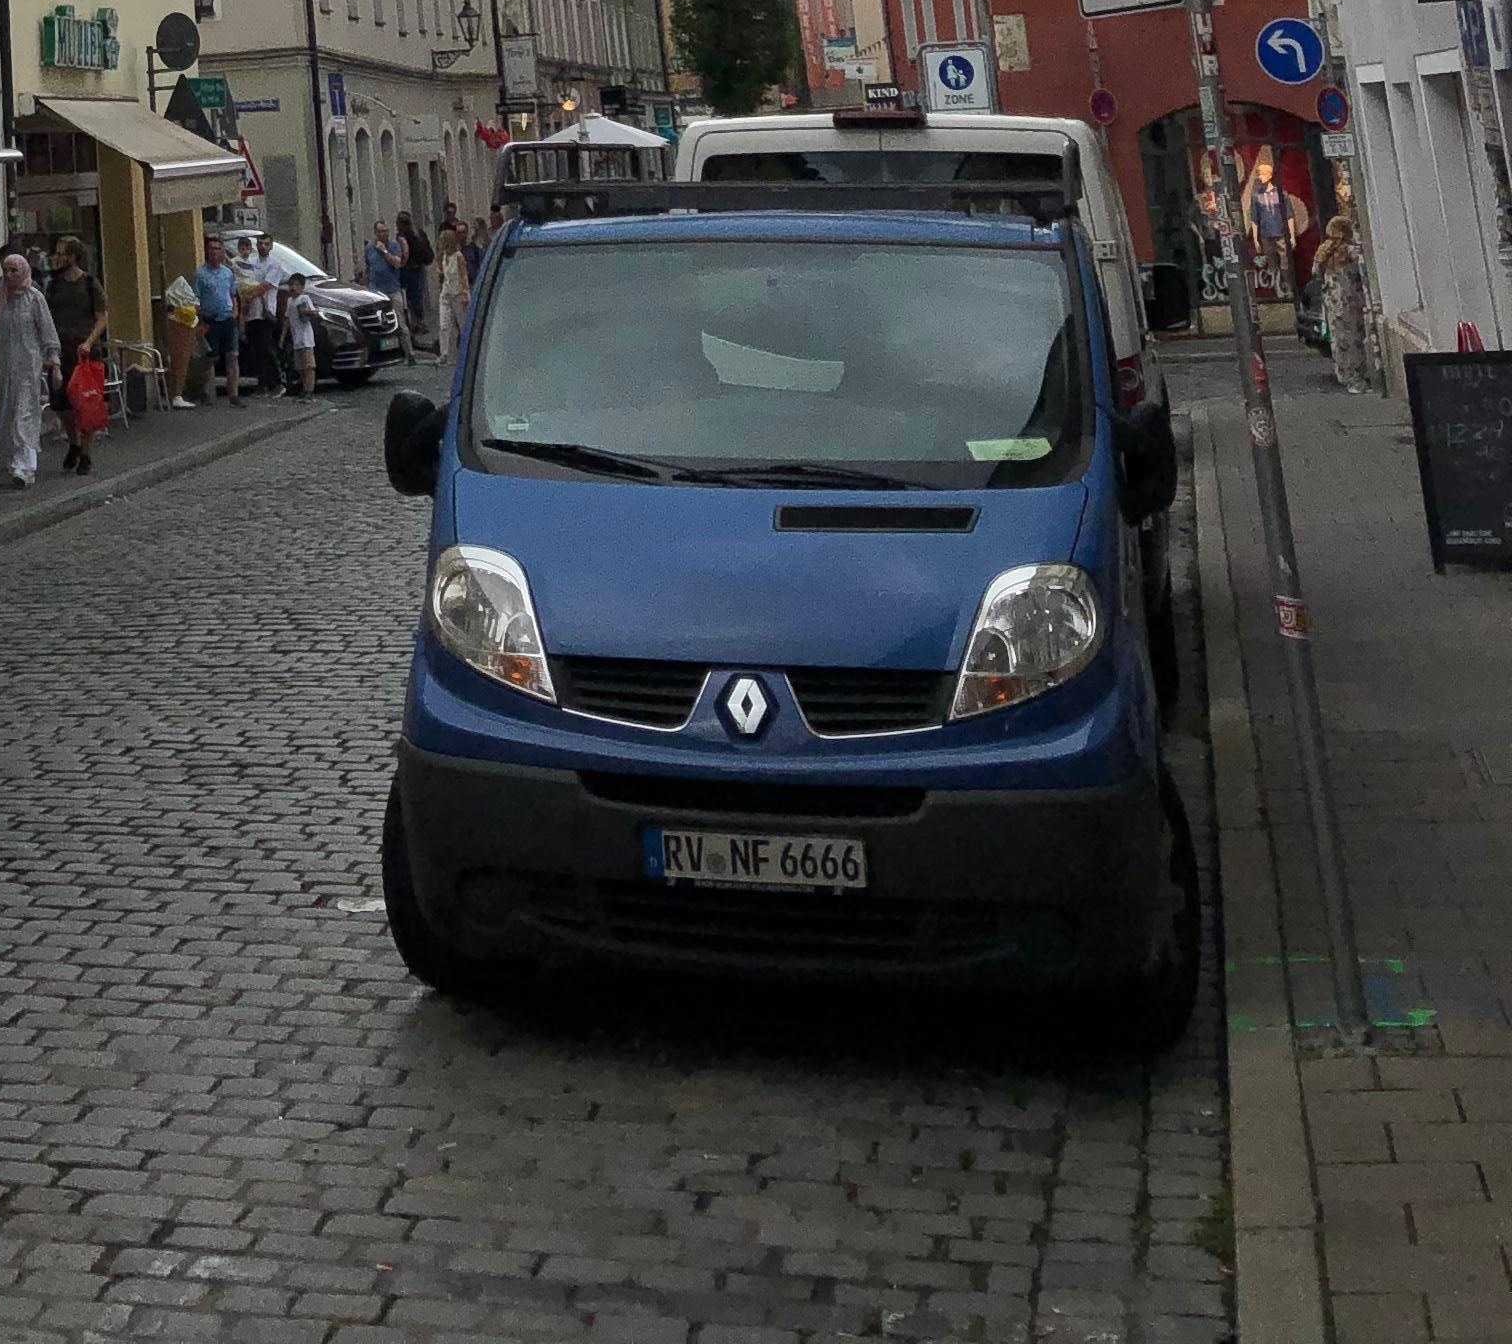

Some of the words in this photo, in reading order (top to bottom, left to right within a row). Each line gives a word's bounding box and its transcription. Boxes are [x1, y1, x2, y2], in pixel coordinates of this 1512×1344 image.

[867, 87, 899, 99] KIND
[944, 93, 975, 105] ZONE
[663, 834, 704, 873] RV
[729, 838, 770, 877] NF
[780, 842, 860, 882] 6666
